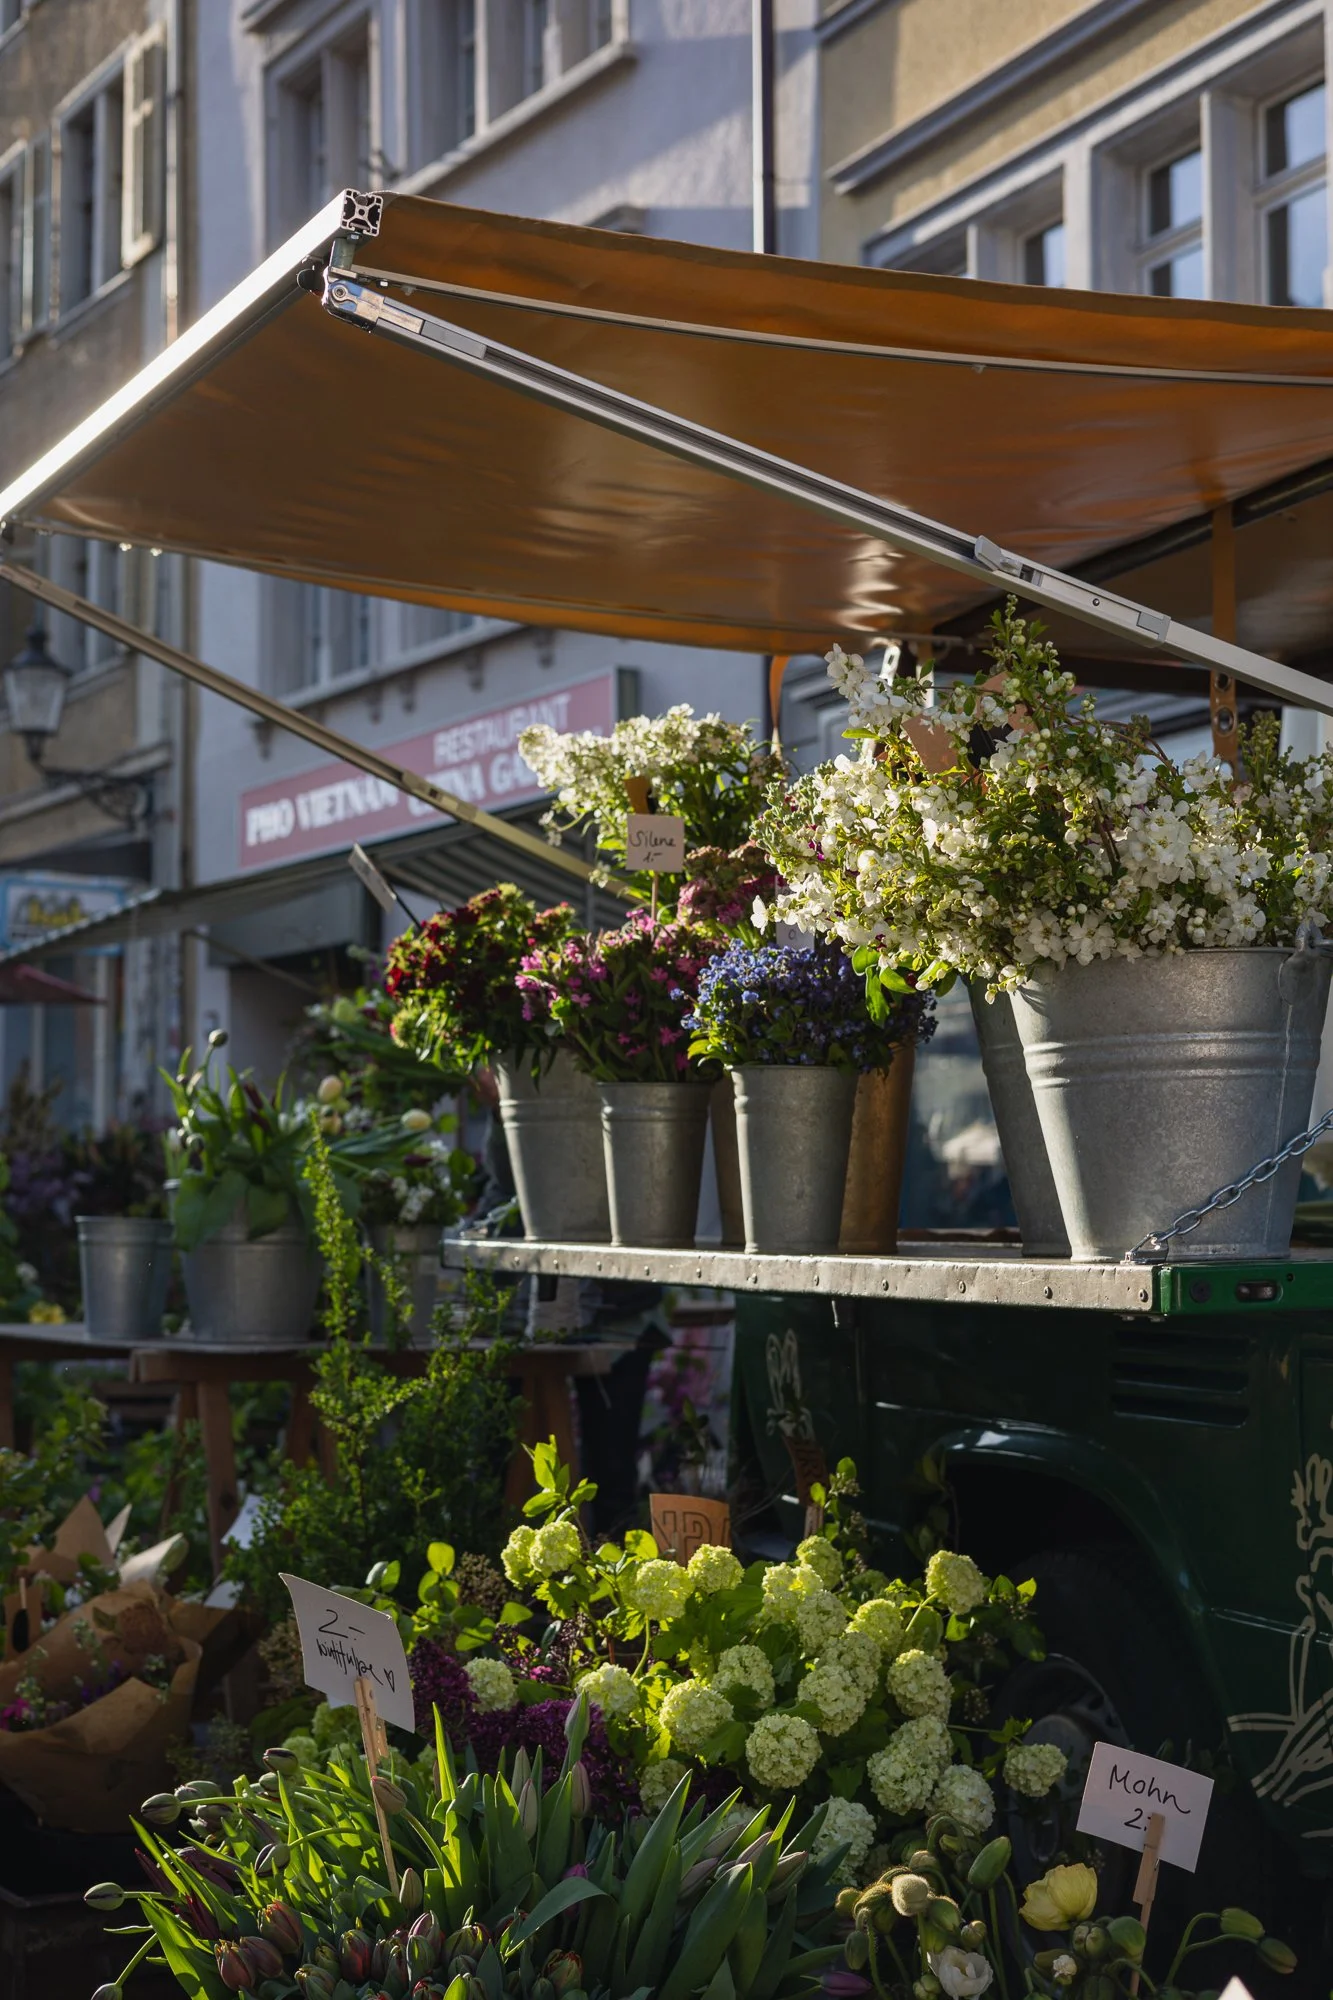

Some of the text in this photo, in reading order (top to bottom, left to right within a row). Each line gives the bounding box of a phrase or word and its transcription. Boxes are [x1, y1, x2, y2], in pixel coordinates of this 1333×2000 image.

[246, 798, 295, 846] PHO
[629, 830, 676, 847] Silene
[1109, 1764, 1191, 1814] Mohn
